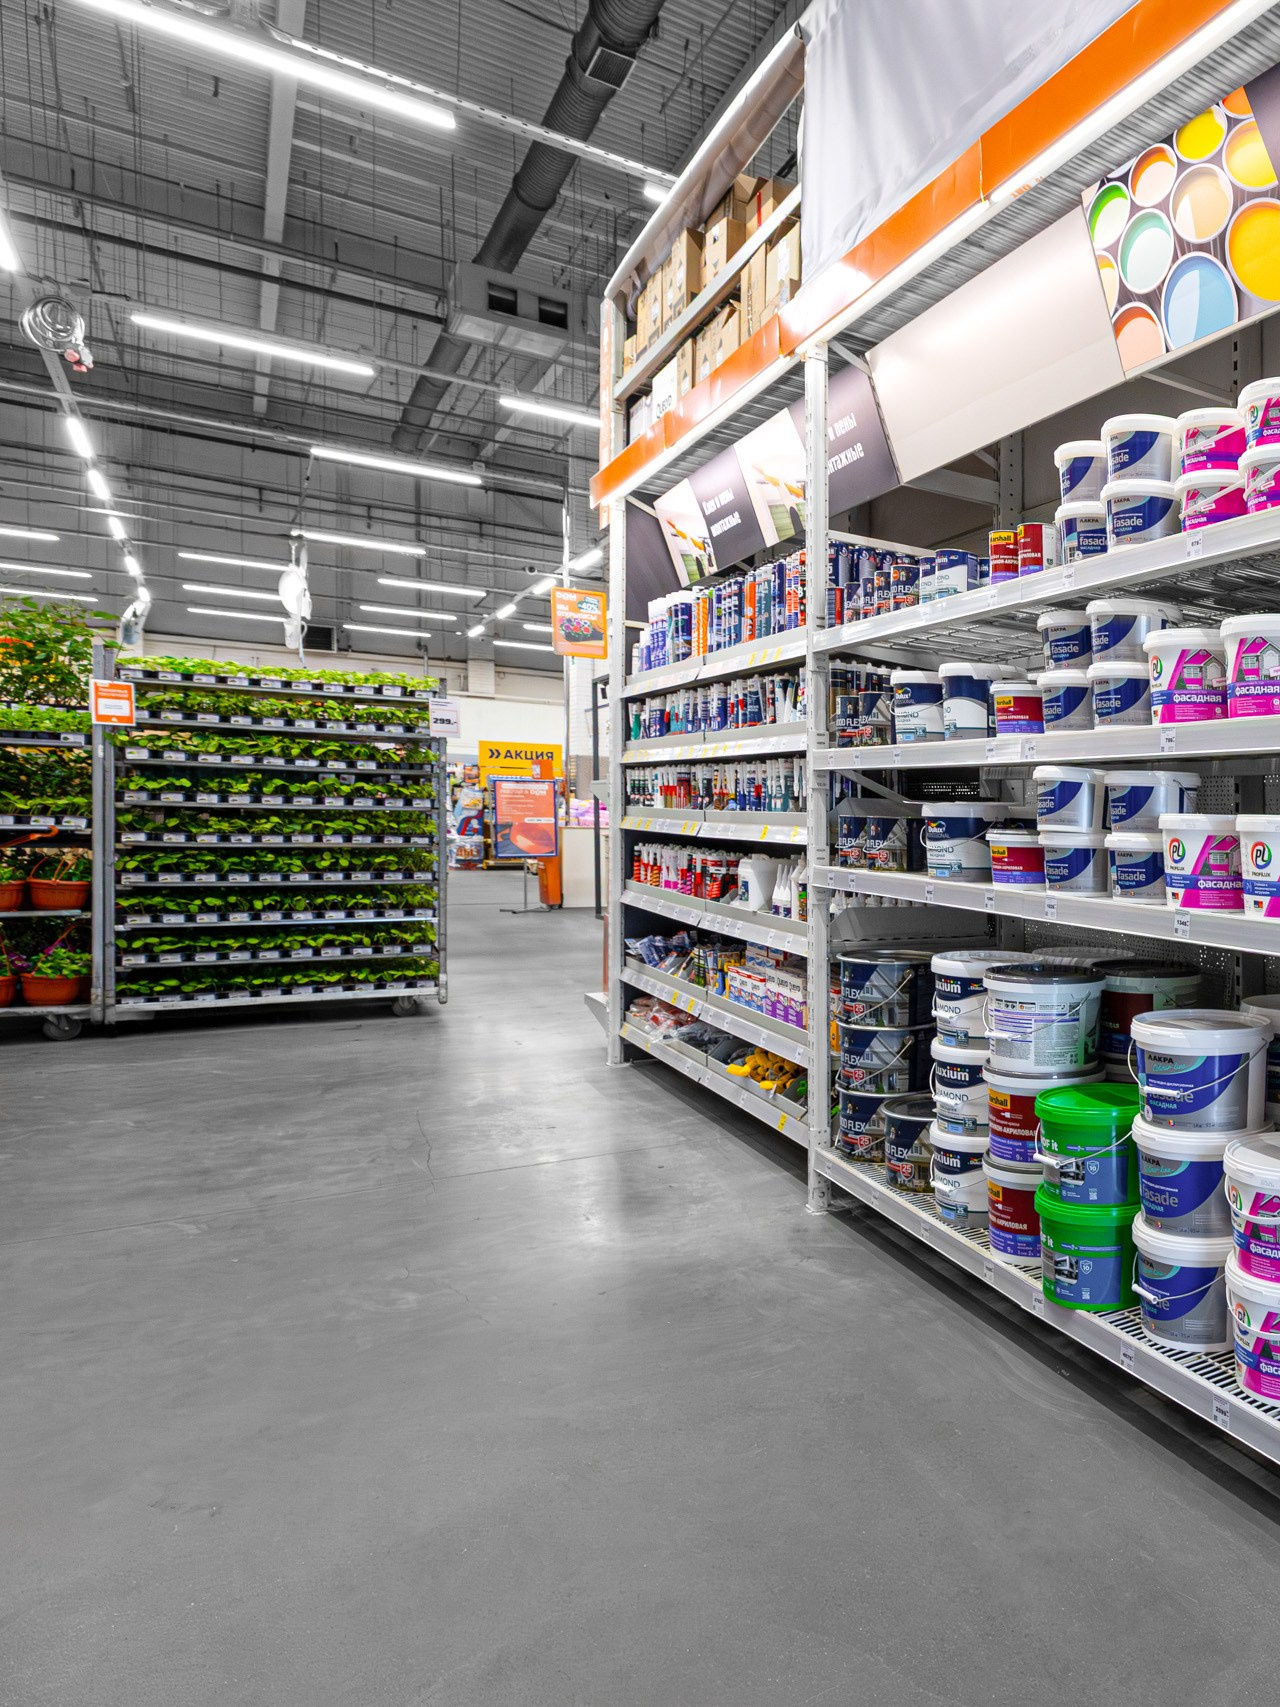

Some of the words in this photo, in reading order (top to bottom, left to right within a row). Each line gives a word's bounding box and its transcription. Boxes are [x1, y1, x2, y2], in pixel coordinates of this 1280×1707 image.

[827, 442, 865, 475] нтажные
[1110, 453, 1129, 465] sade
[1113, 516, 1143, 527] fasade
[1051, 644, 1079, 653] fasade
[1235, 685, 1280, 696] фасадная
[1096, 699, 1121, 708] fasade
[1173, 693, 1222, 703] фасадная
[503, 749, 554, 761] АКЦИЯ
[1117, 870, 1146, 881] fasade
[1197, 879, 1243, 890] фасадна
[1148, 1054, 1174, 1064] ЛАКРА
[848, 1120, 866, 1132] FLEX
[860, 1137, 869, 1145] 25
[1052, 1138, 1058, 1151] it
[890, 1145, 908, 1159] FLEX
[903, 1163, 912, 1172] 25
